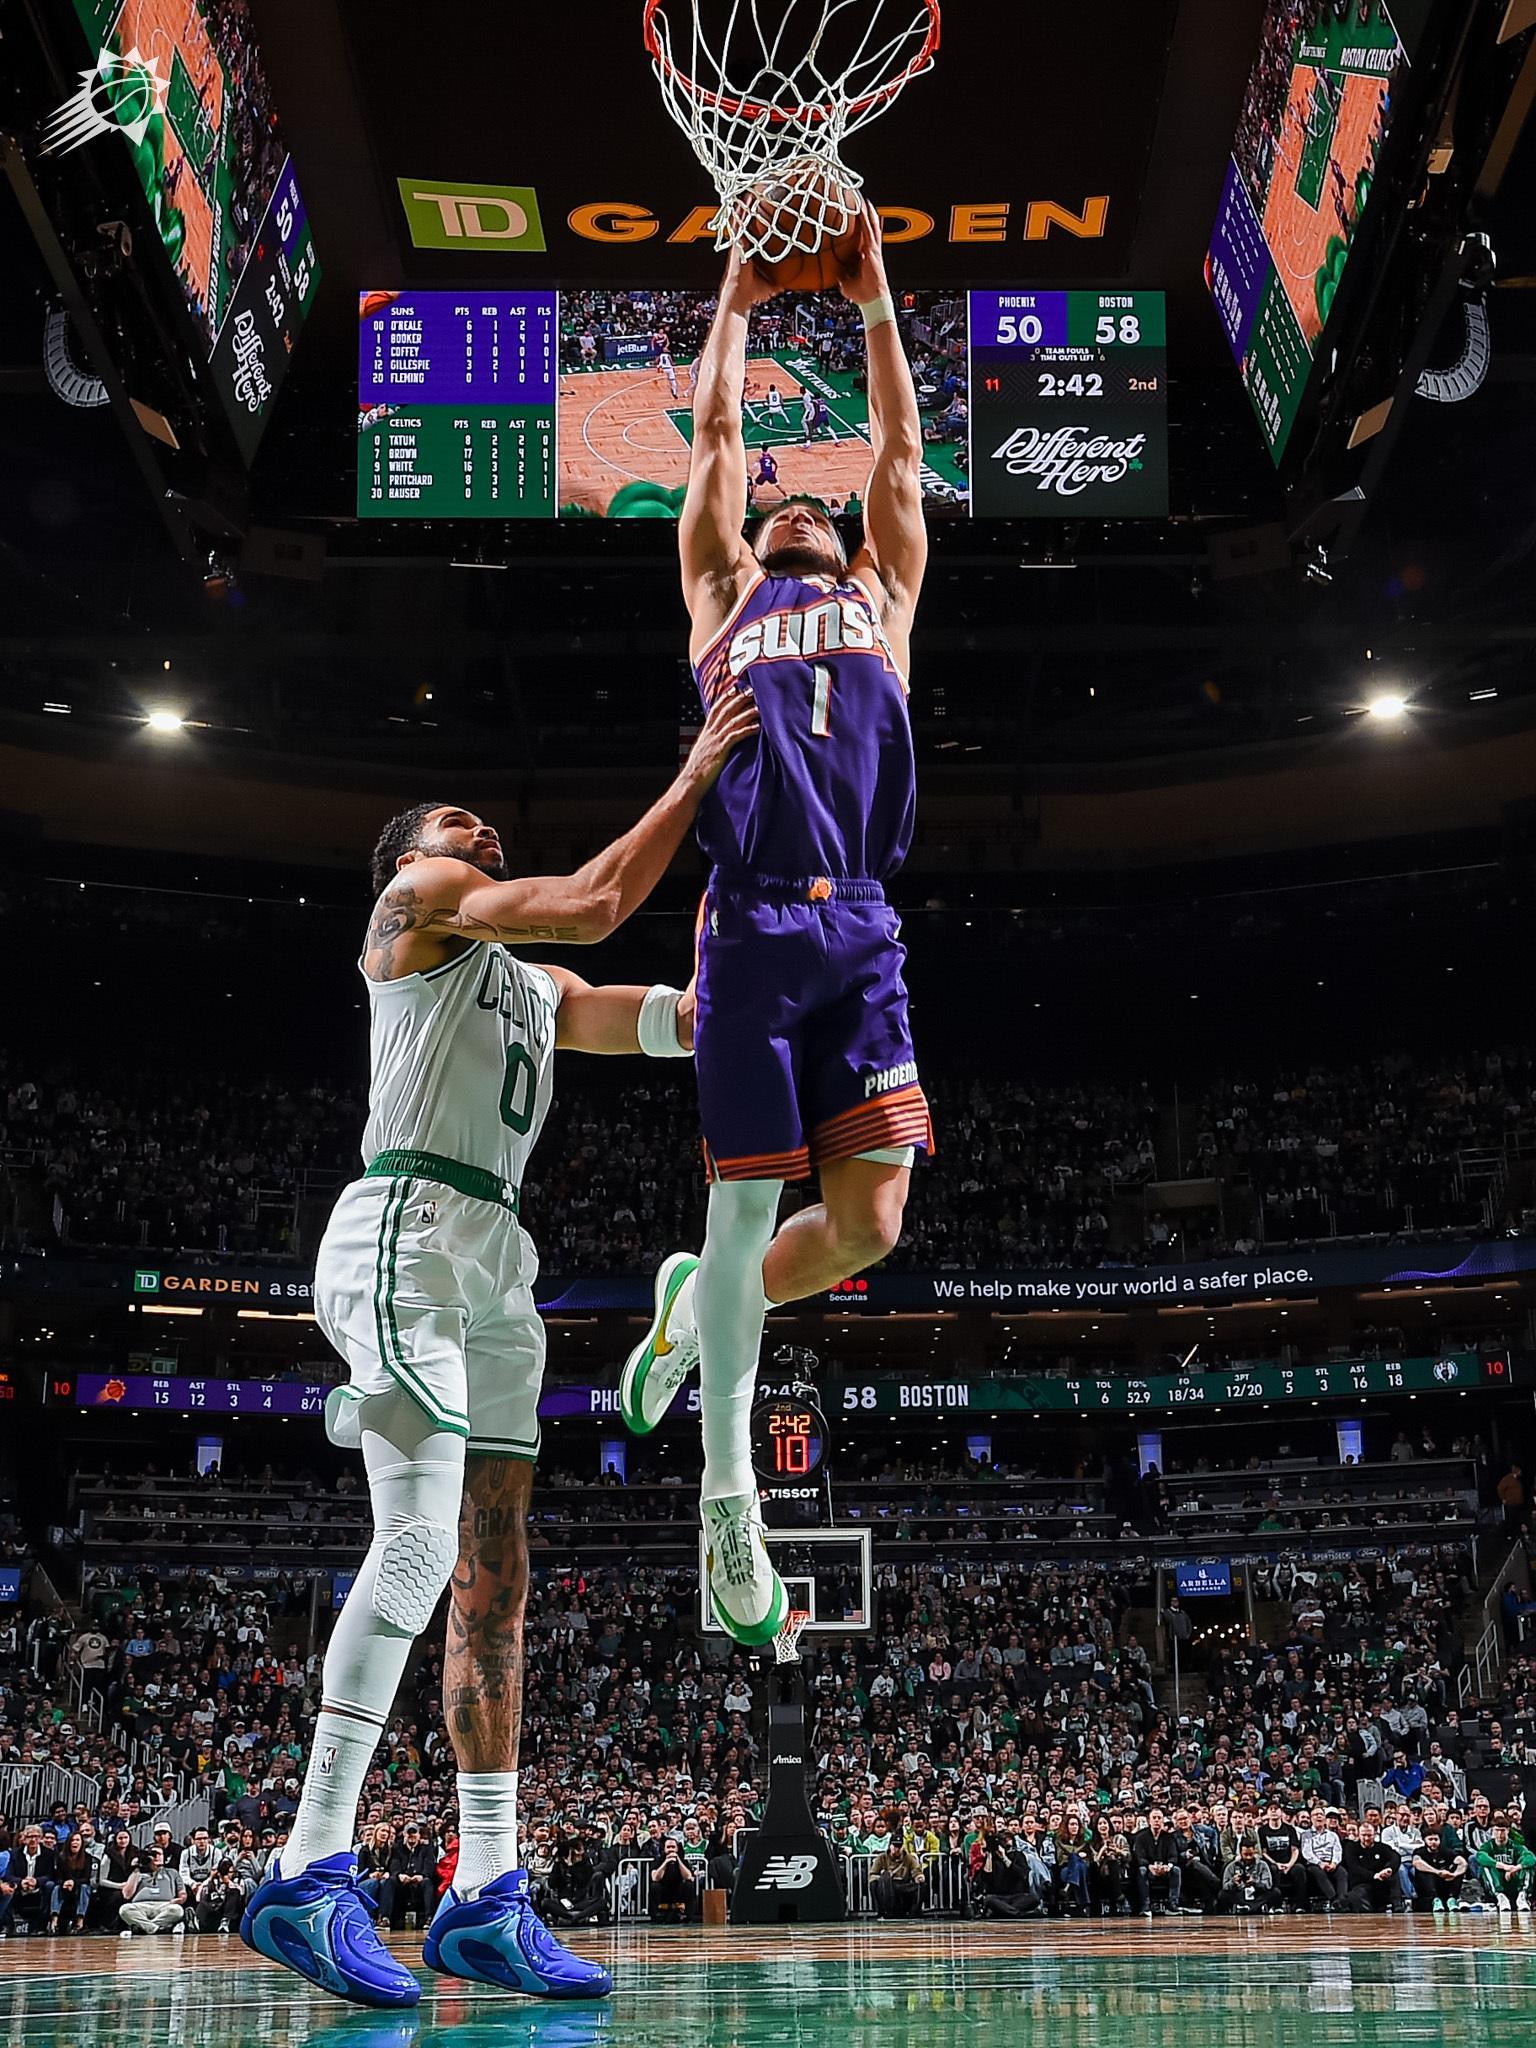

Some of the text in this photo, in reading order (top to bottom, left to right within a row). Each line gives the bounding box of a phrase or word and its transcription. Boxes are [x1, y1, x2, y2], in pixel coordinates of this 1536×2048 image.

[276, 198, 292, 241] 50
[413, 192, 1109, 242] TD GADEN
[294, 258, 310, 301] 58
[998, 296, 1133, 308] PHOENIX BOSTON
[390, 306, 552, 316] SUNS PTS REB AST FLS
[373, 319, 549, 331] 00 O'NEALE 6 1 2 1
[996, 316, 1141, 343] 50 58
[376, 333, 381, 344] 1
[390, 332, 422, 344] BOOKER
[466, 332, 473, 344] 8
[493, 332, 498, 344] 1
[543, 333, 550, 344] 0
[234, 309, 272, 401] Different
[375, 345, 550, 358] 2 COFFEY 0 0 0 0
[617, 344, 648, 355] jetBlue
[374, 358, 549, 371] 12 GILLESPIE 3 2 1 1
[232, 350, 262, 413] Here
[372, 372, 549, 384] 20 FLEMING 0 1 0 0
[985, 374, 1157, 396] 11 2:42 2nd
[389, 418, 551, 429] CELTICS PTS REB AST FLS
[374, 434, 549, 446] 0 TATUM 8 2 2 0
[991, 427, 1146, 465] Different
[374, 448, 380, 459] 7
[388, 448, 418, 459] BROWN
[463, 447, 473, 459] 17
[491, 447, 498, 459] 2
[542, 447, 549, 459] 0
[374, 460, 548, 473] 9 WHITE 16 3 2 1
[373, 474, 548, 486] 11 PRITCHARD 8 3 2 1
[1006, 458, 1127, 495] Here
[370, 487, 548, 499] 30 HAUSER 0 2 1 1
[730, 600, 874, 676] SUNS
[812, 663, 832, 737] 1
[500, 1042, 536, 1136] 0
[137, 1274, 157, 1288] TD
[164, 1276, 259, 1293] GARDEN
[933, 1268, 1313, 1299] We help make your world a safer place.
[829, 1293, 868, 1301] Securitas
[1066, 1381, 1081, 1390] FLS
[1095, 1381, 1112, 1389] TOL
[1234, 1373, 1250, 1382] 3PT
[1281, 1370, 1294, 1378] TO
[1315, 1367, 1329, 1376] STL
[1349, 1365, 1366, 1374] AST
[1385, 1362, 1402, 1371] REB
[1073, 1361, 1504, 1405] 1 6 52.9 18/34 12/20 5 3 16 18 10
[54, 1382, 70, 1395] 10
[152, 1380, 321, 1395] REB AST STL TO 3PT
[155, 1391, 325, 1411] 15 12 3 4 8/1
[842, 1385, 969, 1409] 58 BOSTON
[769, 1415, 810, 1434] 2:42
[776, 1436, 808, 1472] 10
[769, 1488, 819, 1498] TISSOT
[1181, 1579, 1226, 1587] ARBELLA
[773, 1755, 802, 1764] Amica
